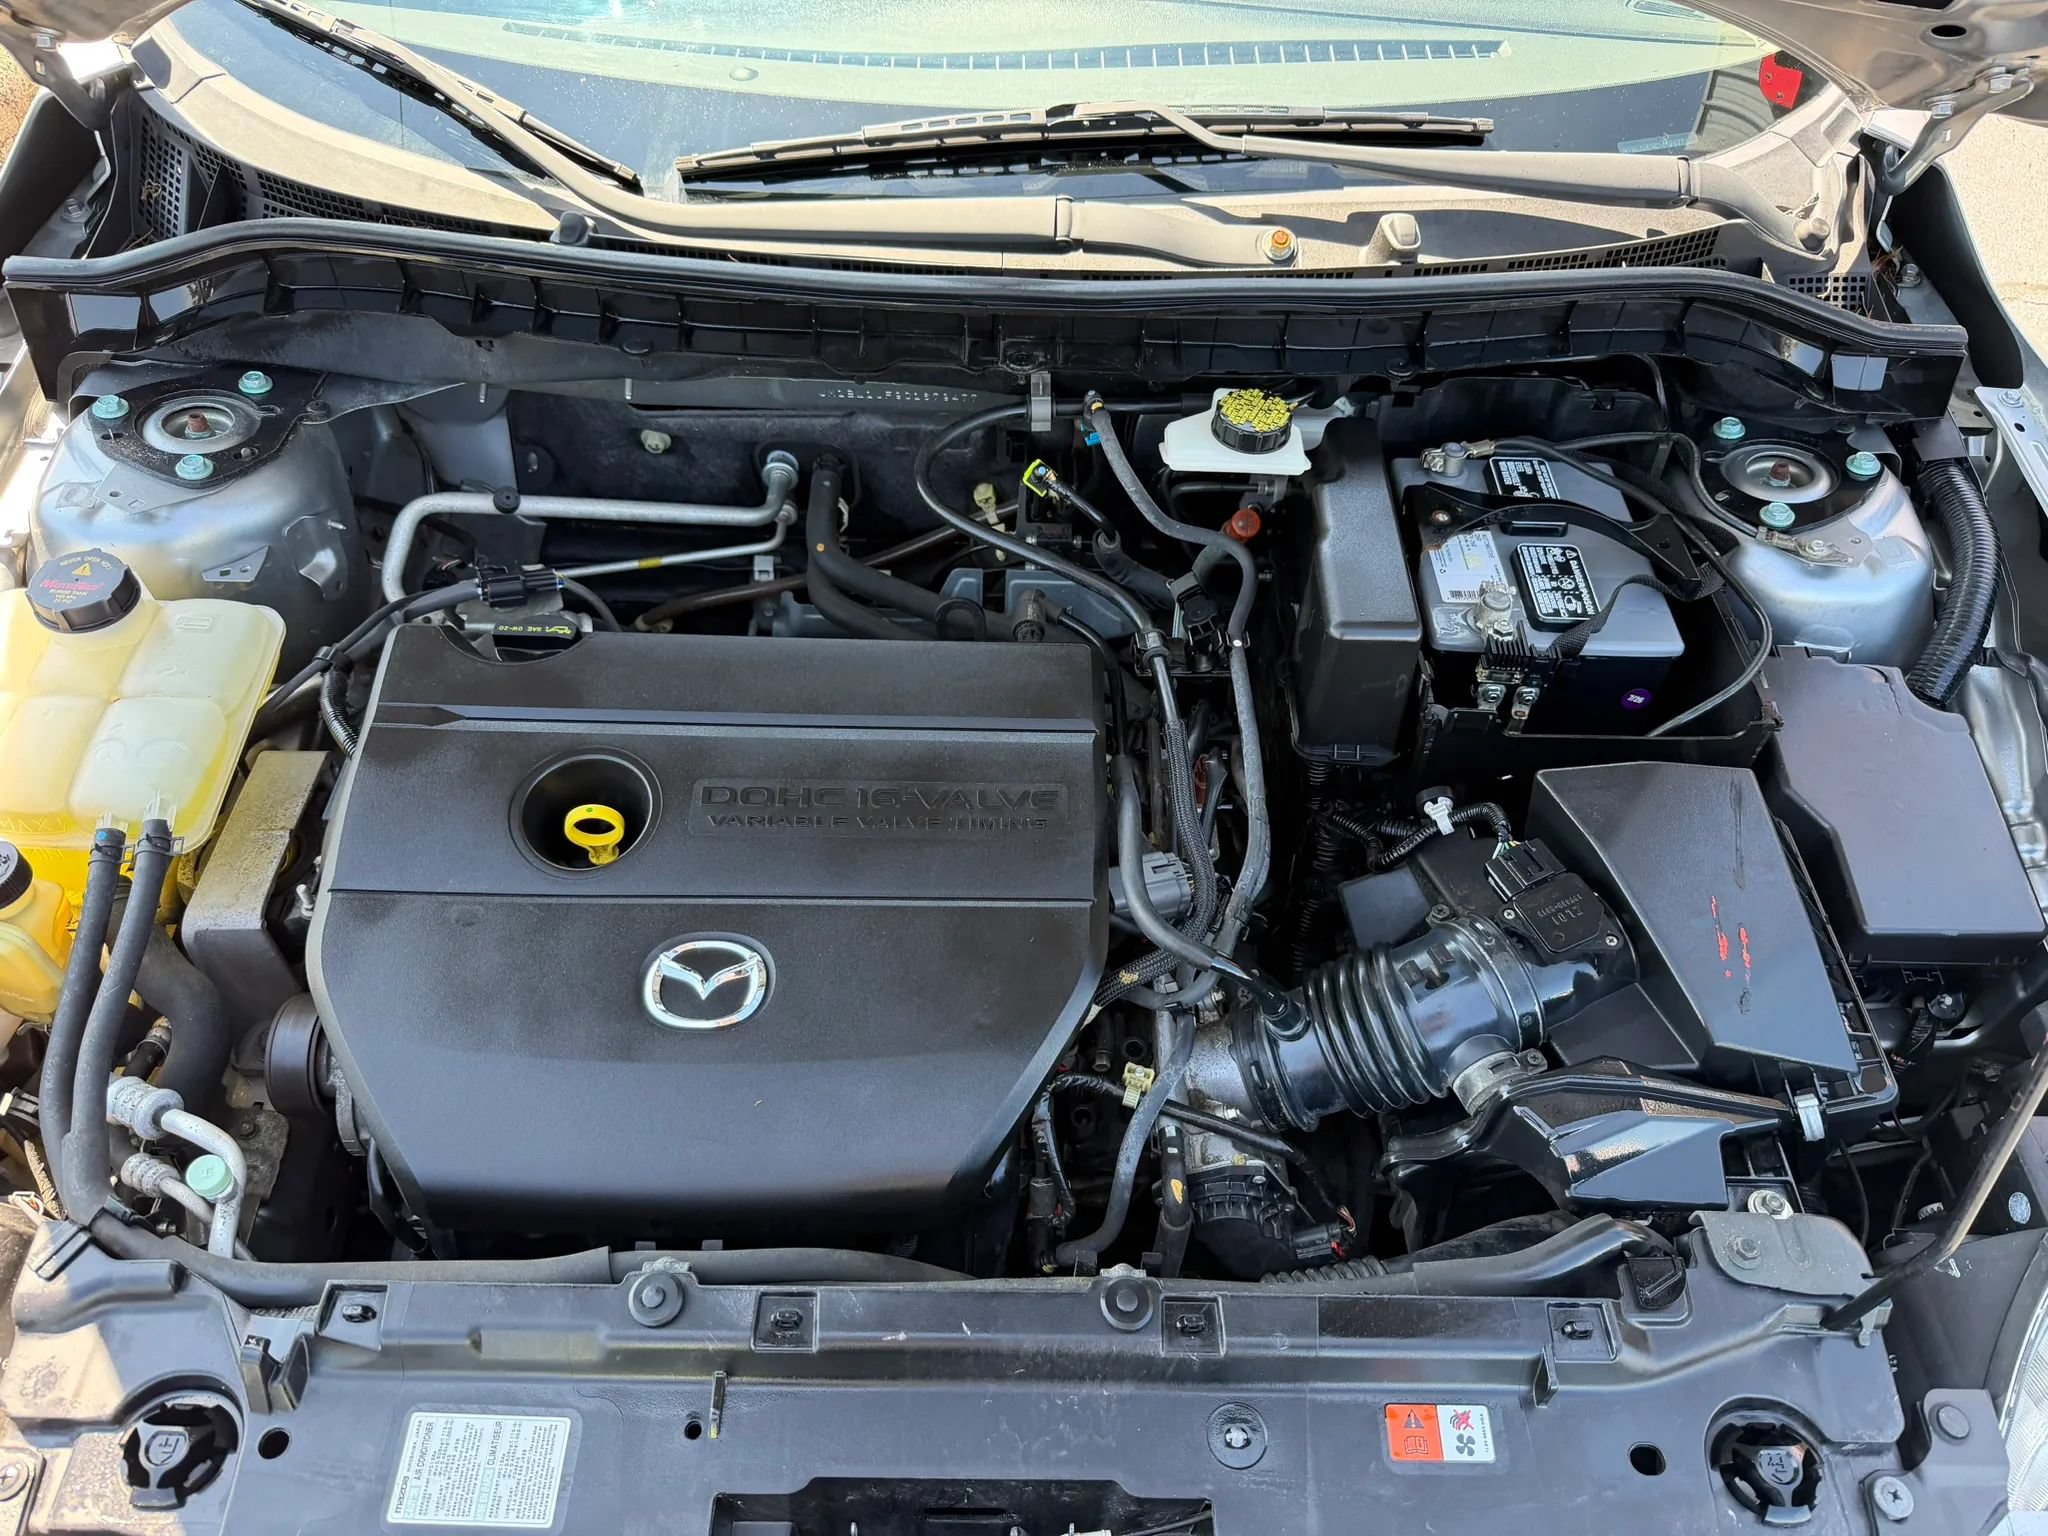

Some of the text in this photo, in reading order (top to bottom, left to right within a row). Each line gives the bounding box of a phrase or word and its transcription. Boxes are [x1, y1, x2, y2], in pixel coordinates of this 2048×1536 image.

[701, 786, 1061, 811] DOHC 16-VALVE
[708, 815, 1048, 832] VARIABLE VALVE TIMING
[415, 1422, 434, 1480] AIR CONDITIONER
[488, 1420, 503, 1465] CLIMATISEUR
[395, 1476, 409, 1513] mazda
